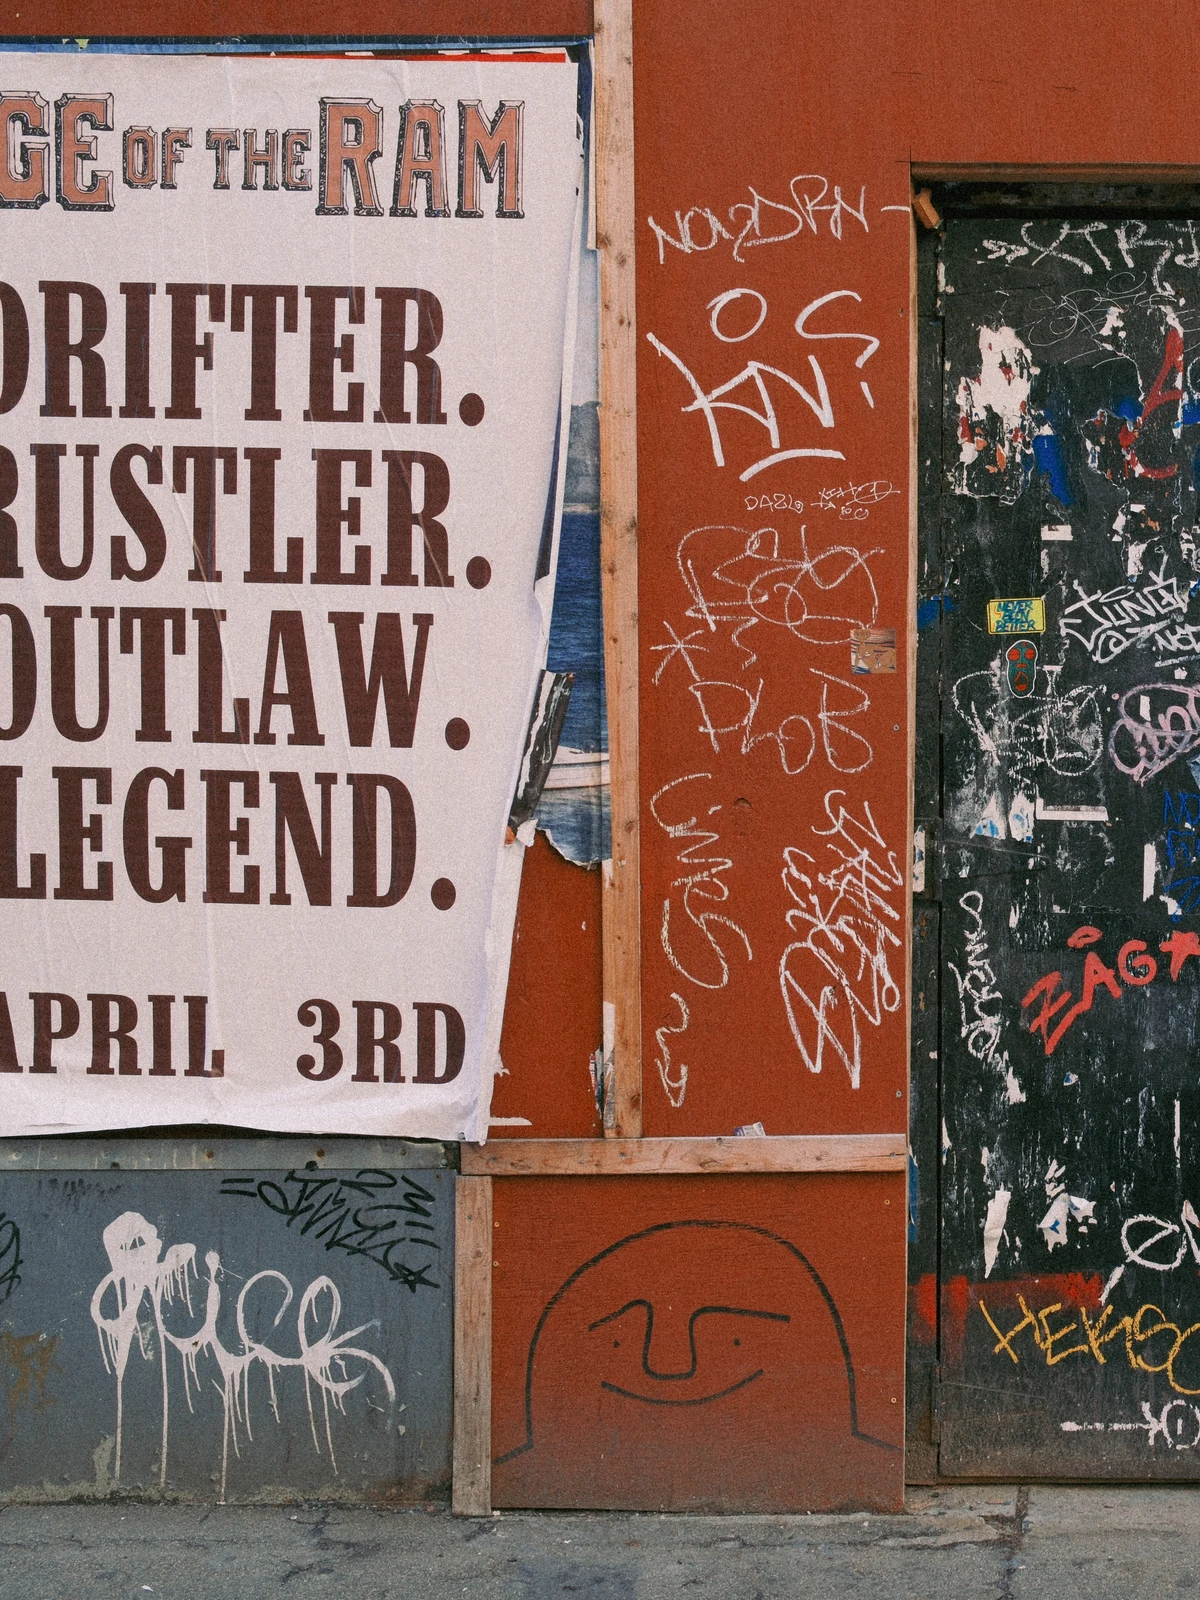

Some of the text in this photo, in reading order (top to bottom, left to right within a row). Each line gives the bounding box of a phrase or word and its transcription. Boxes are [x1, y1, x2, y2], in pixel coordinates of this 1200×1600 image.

[122, 125, 193, 190] OF
[205, 128, 313, 191] THE
[315, 96, 525, 219] RAM
[994, 619, 1037, 633] BETTER
[996, 600, 1034, 613] NEVER
[0, 764, 457, 911] LEGEND.
[296, 998, 467, 1085] 3RD
